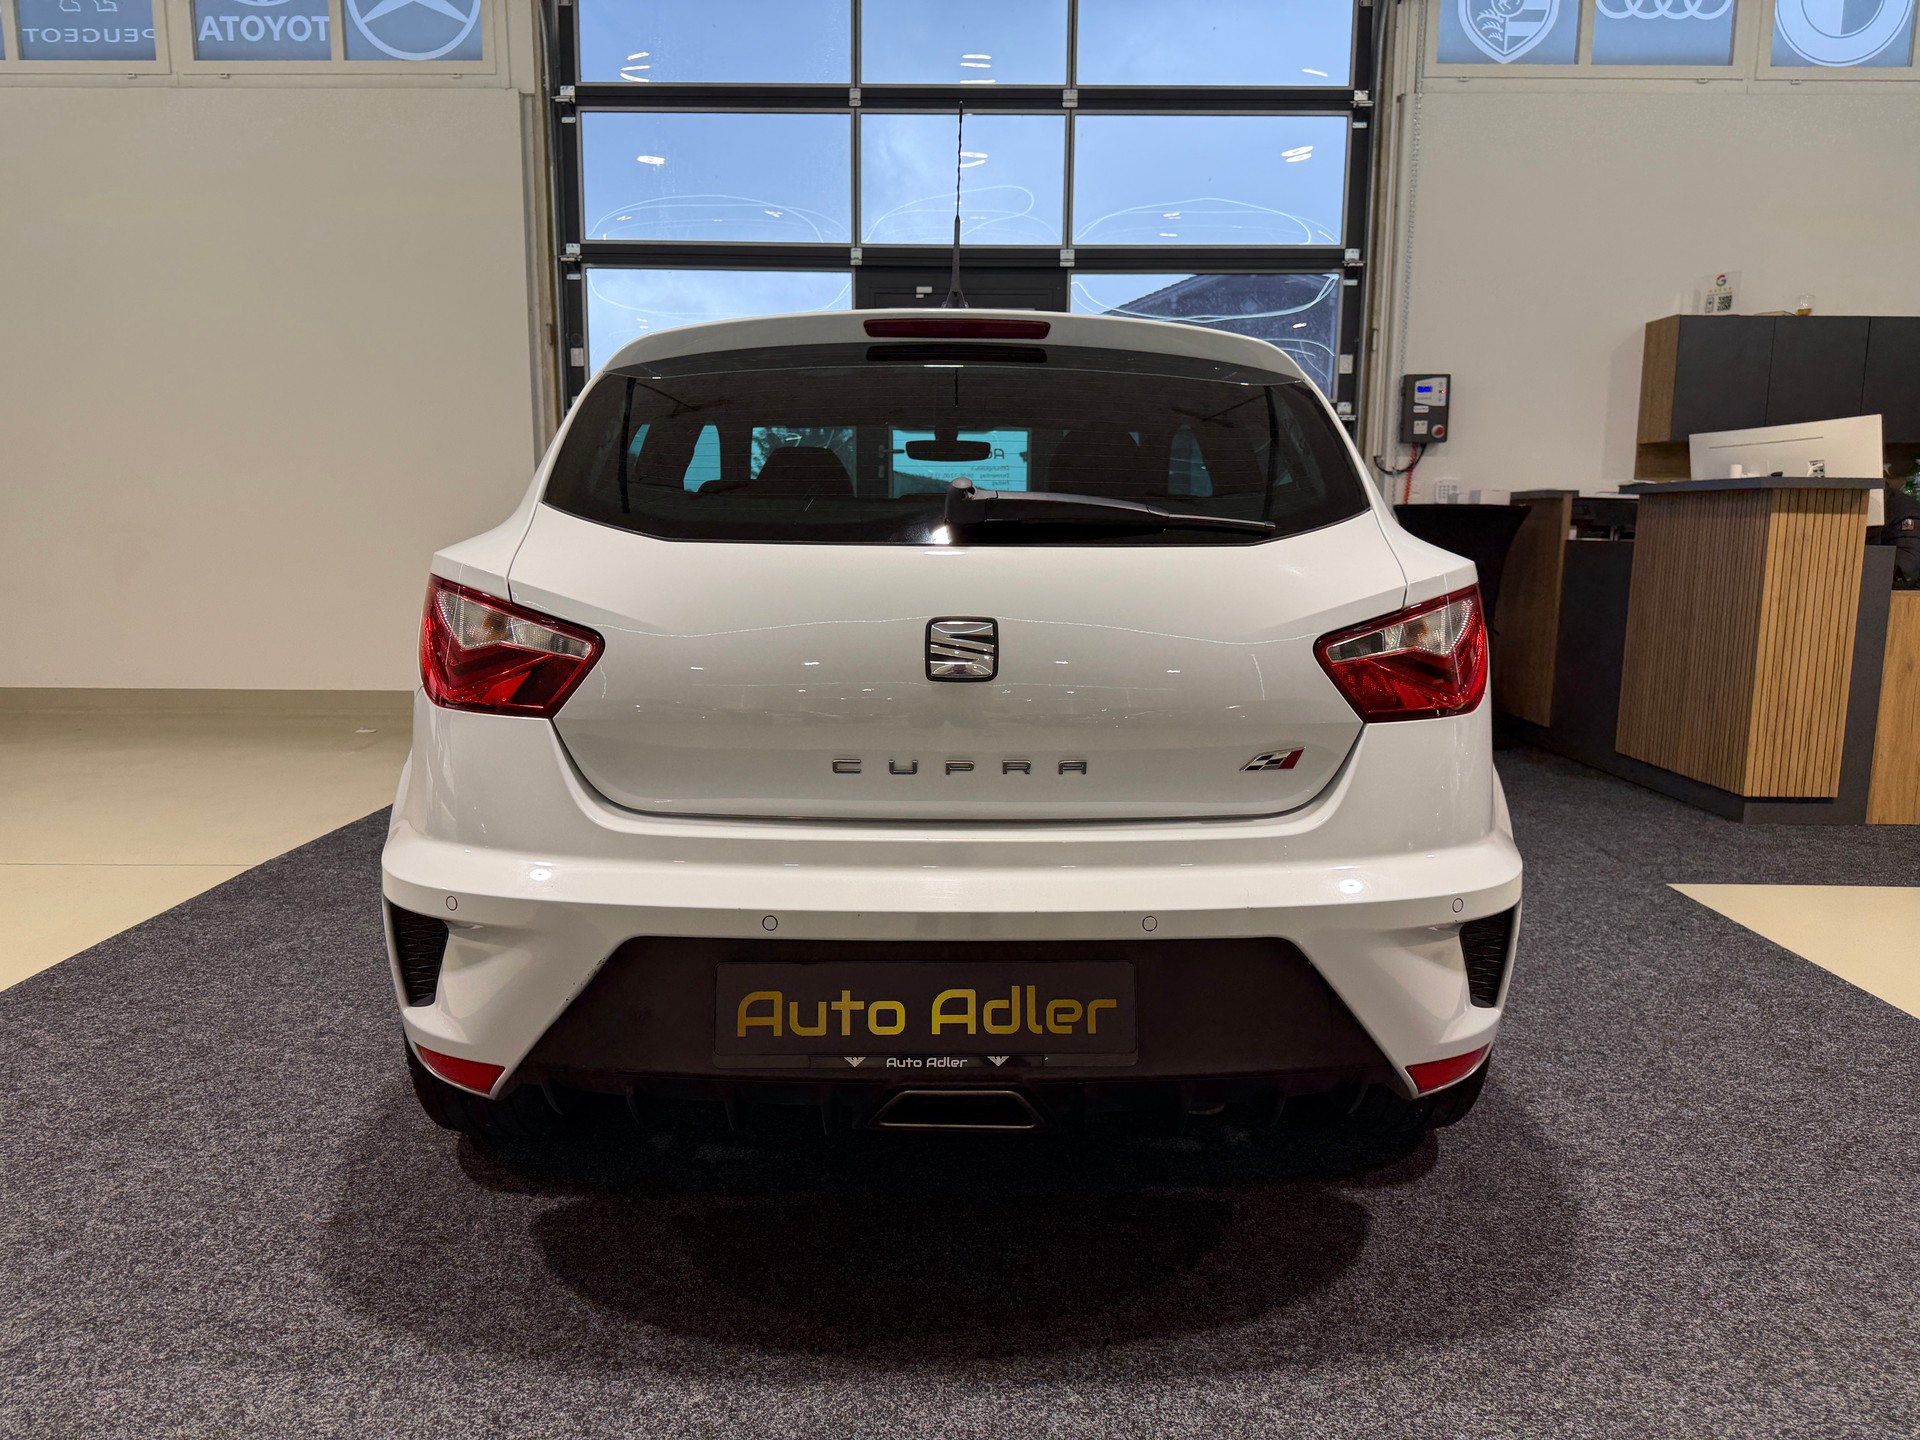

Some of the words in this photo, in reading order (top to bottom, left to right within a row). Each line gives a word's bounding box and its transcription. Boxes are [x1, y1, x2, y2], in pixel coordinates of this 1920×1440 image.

[832, 758, 1088, 776] CUPRA
[737, 990, 906, 1037] Auto
[931, 985, 1117, 1035] Adler
[886, 1057, 923, 1069] Auto
[926, 1056, 968, 1069] Adler
